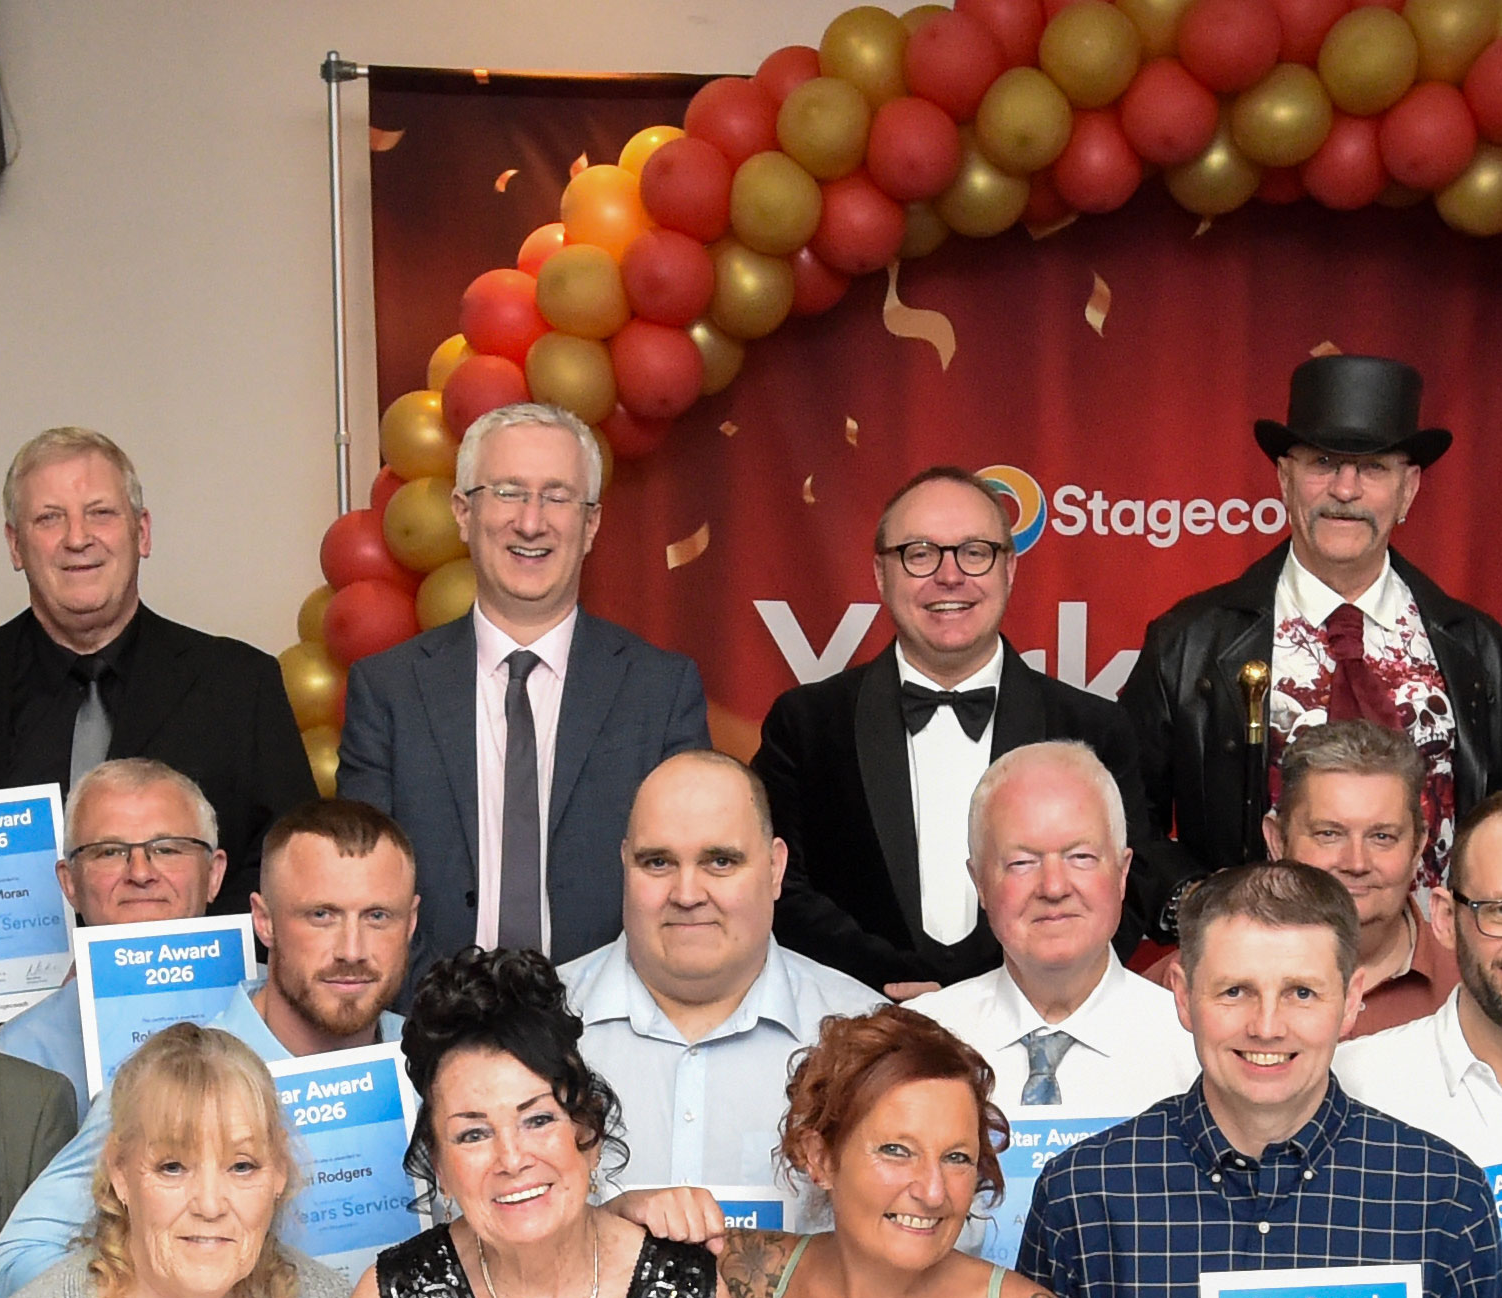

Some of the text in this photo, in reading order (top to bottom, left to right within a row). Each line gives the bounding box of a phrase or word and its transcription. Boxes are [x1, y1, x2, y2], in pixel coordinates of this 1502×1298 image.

[1052, 484, 1287, 548] Stageco
[2, 914, 60, 931] Service
[114, 939, 220, 966] Star Award
[146, 965, 194, 985] 2026
[277, 1071, 374, 1105] ar Award
[294, 1101, 347, 1126] 2026
[317, 1167, 373, 1184] Rodgers
[297, 1207, 337, 1224] ears
[342, 1195, 411, 1217] Service
[724, 1210, 757, 1229] ard
